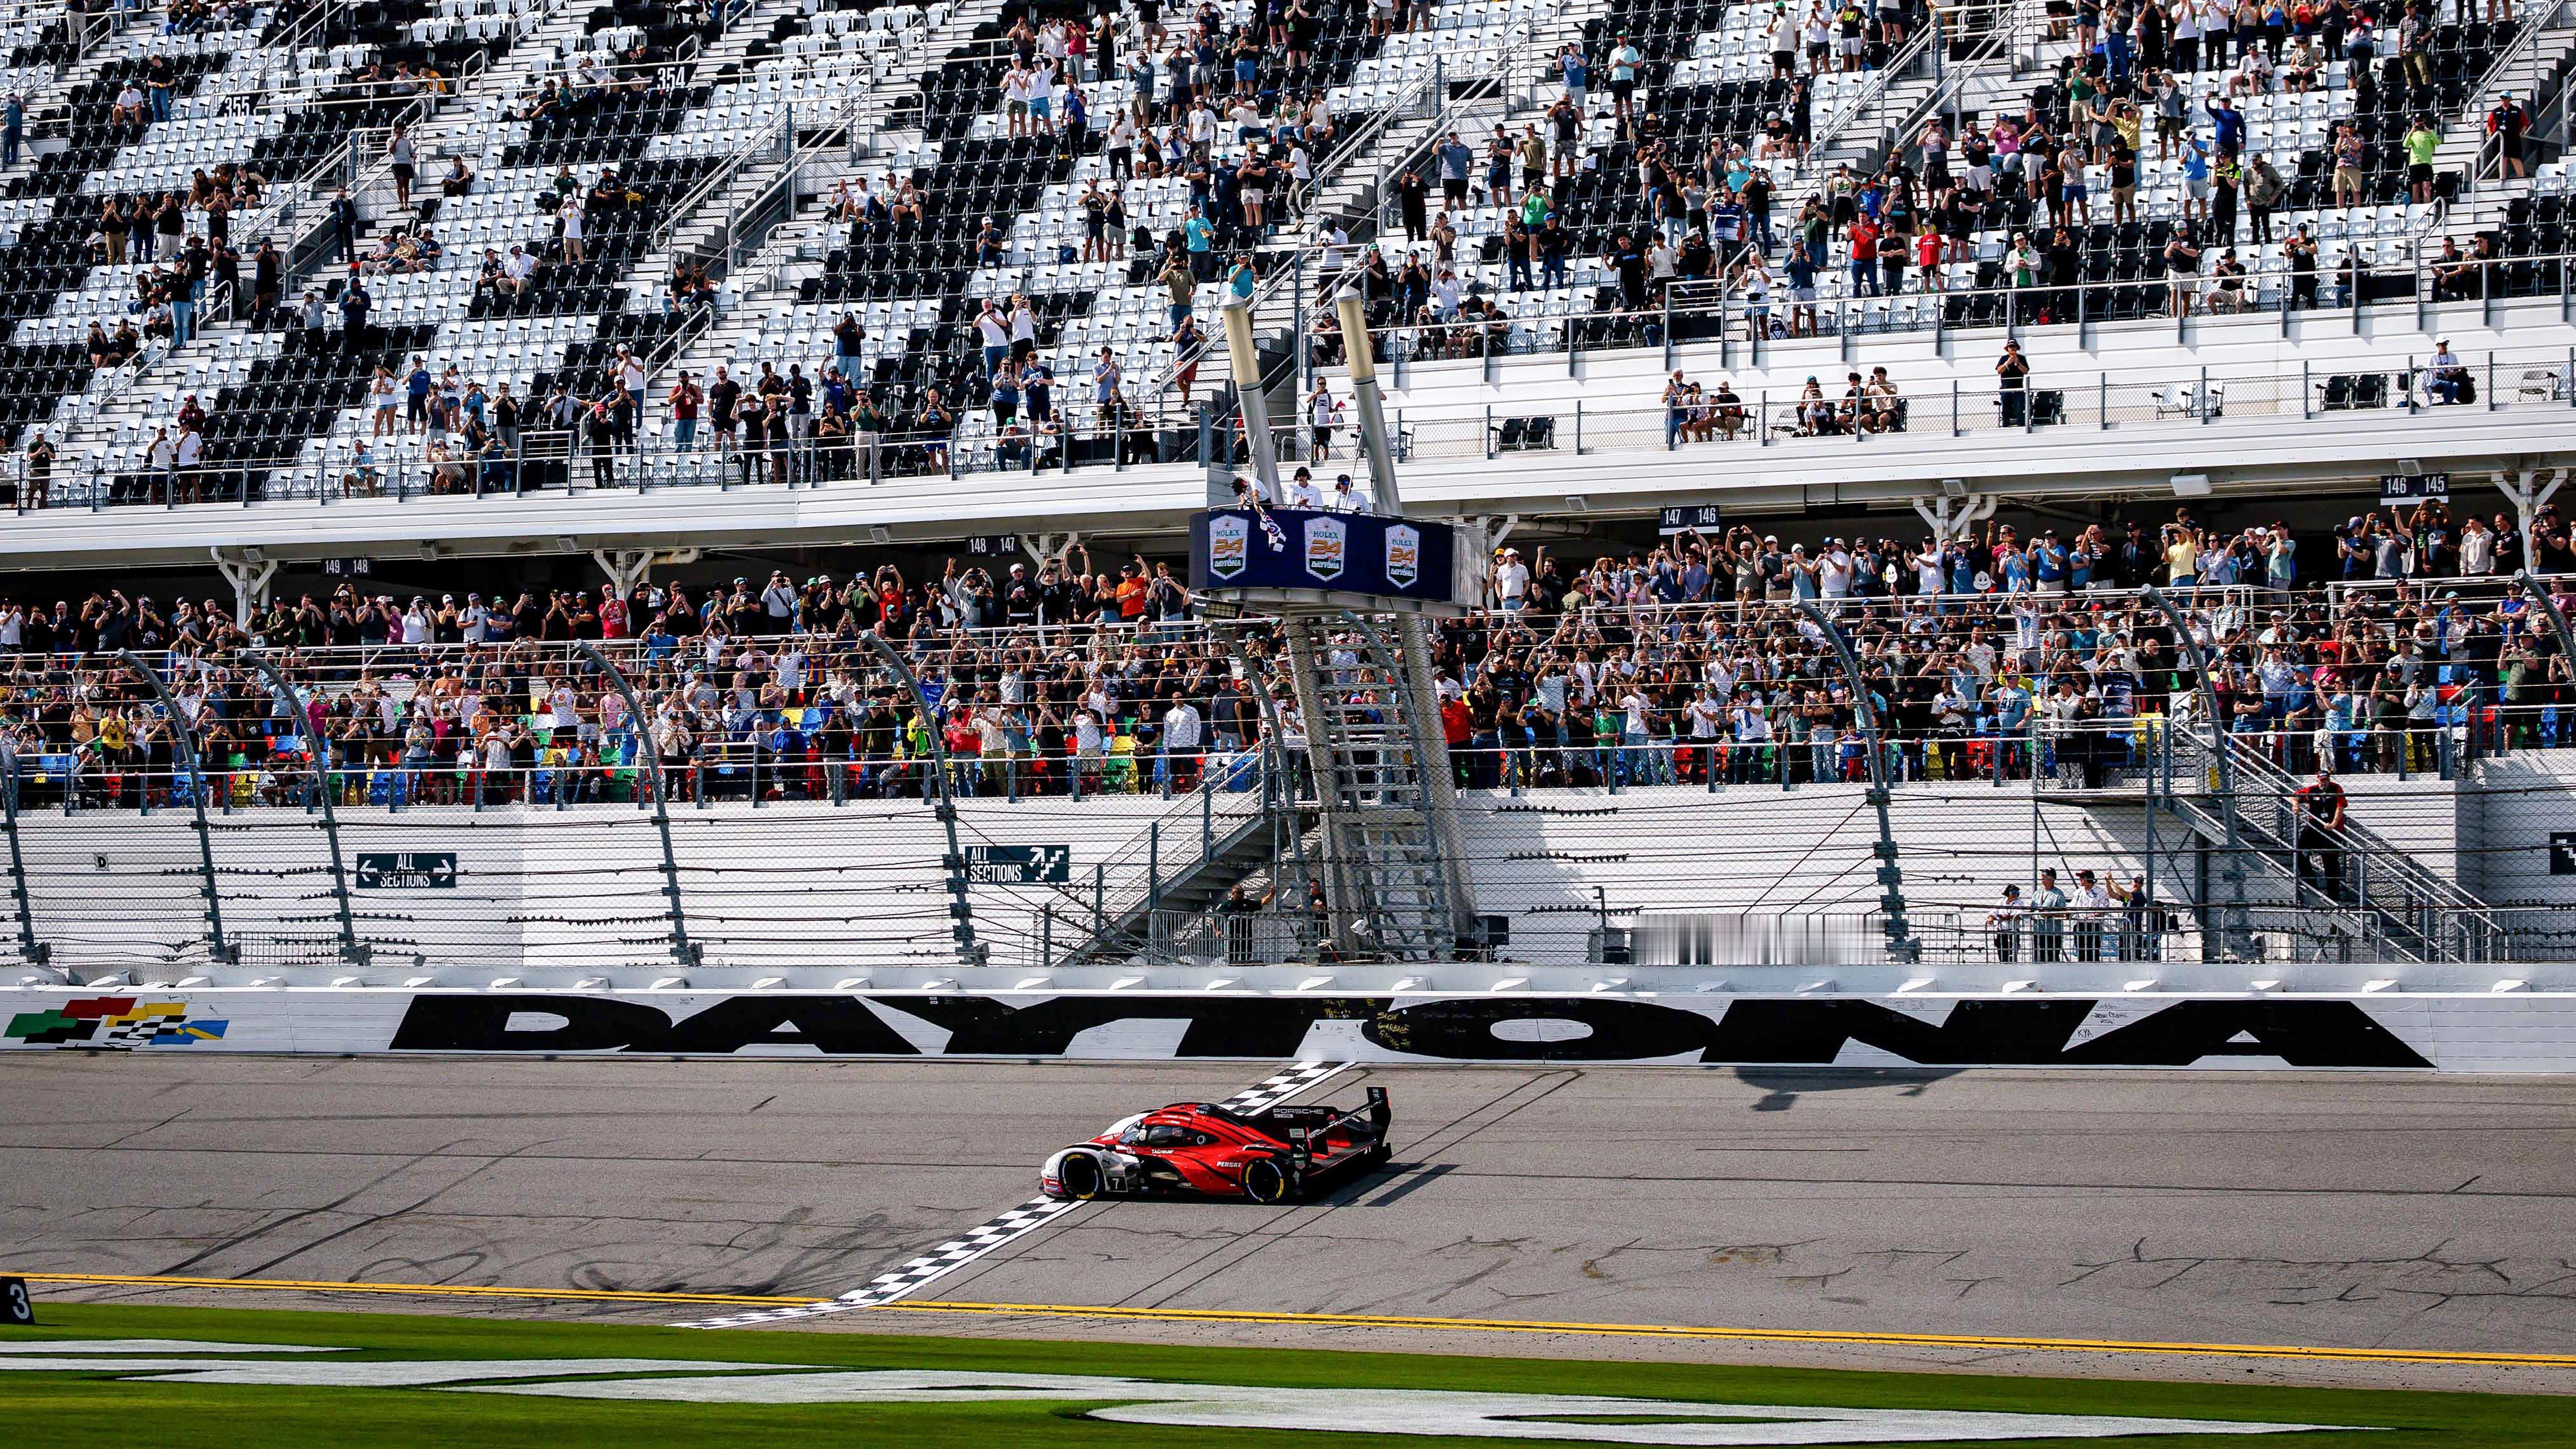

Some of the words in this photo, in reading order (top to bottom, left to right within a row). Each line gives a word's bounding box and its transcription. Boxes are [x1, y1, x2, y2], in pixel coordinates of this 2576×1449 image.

[657, 66, 685, 90] 354
[225, 96, 250, 117] 355
[2387, 479, 2407, 496] 146
[2424, 475, 2445, 492] 145
[1665, 508, 1680, 525] 147
[1698, 507, 1716, 523] 146
[970, 538, 987, 553] 148
[999, 536, 1015, 552] 147
[1213, 538, 1244, 554] 24
[1309, 539, 1342, 555] 24
[1389, 547, 1415, 563] 24
[325, 559, 340, 574] 149
[352, 558, 368, 573] 148
[98, 855, 107, 868] D
[396, 854, 415, 870] ALL
[970, 846, 990, 865] ALL
[380, 871, 430, 888] SECTIONS
[969, 864, 1022, 882] SECTIONS
[390, 994, 2436, 1069] DAYTONA
[1112, 1178, 1120, 1190] 7
[9, 1284, 30, 1320] 3
